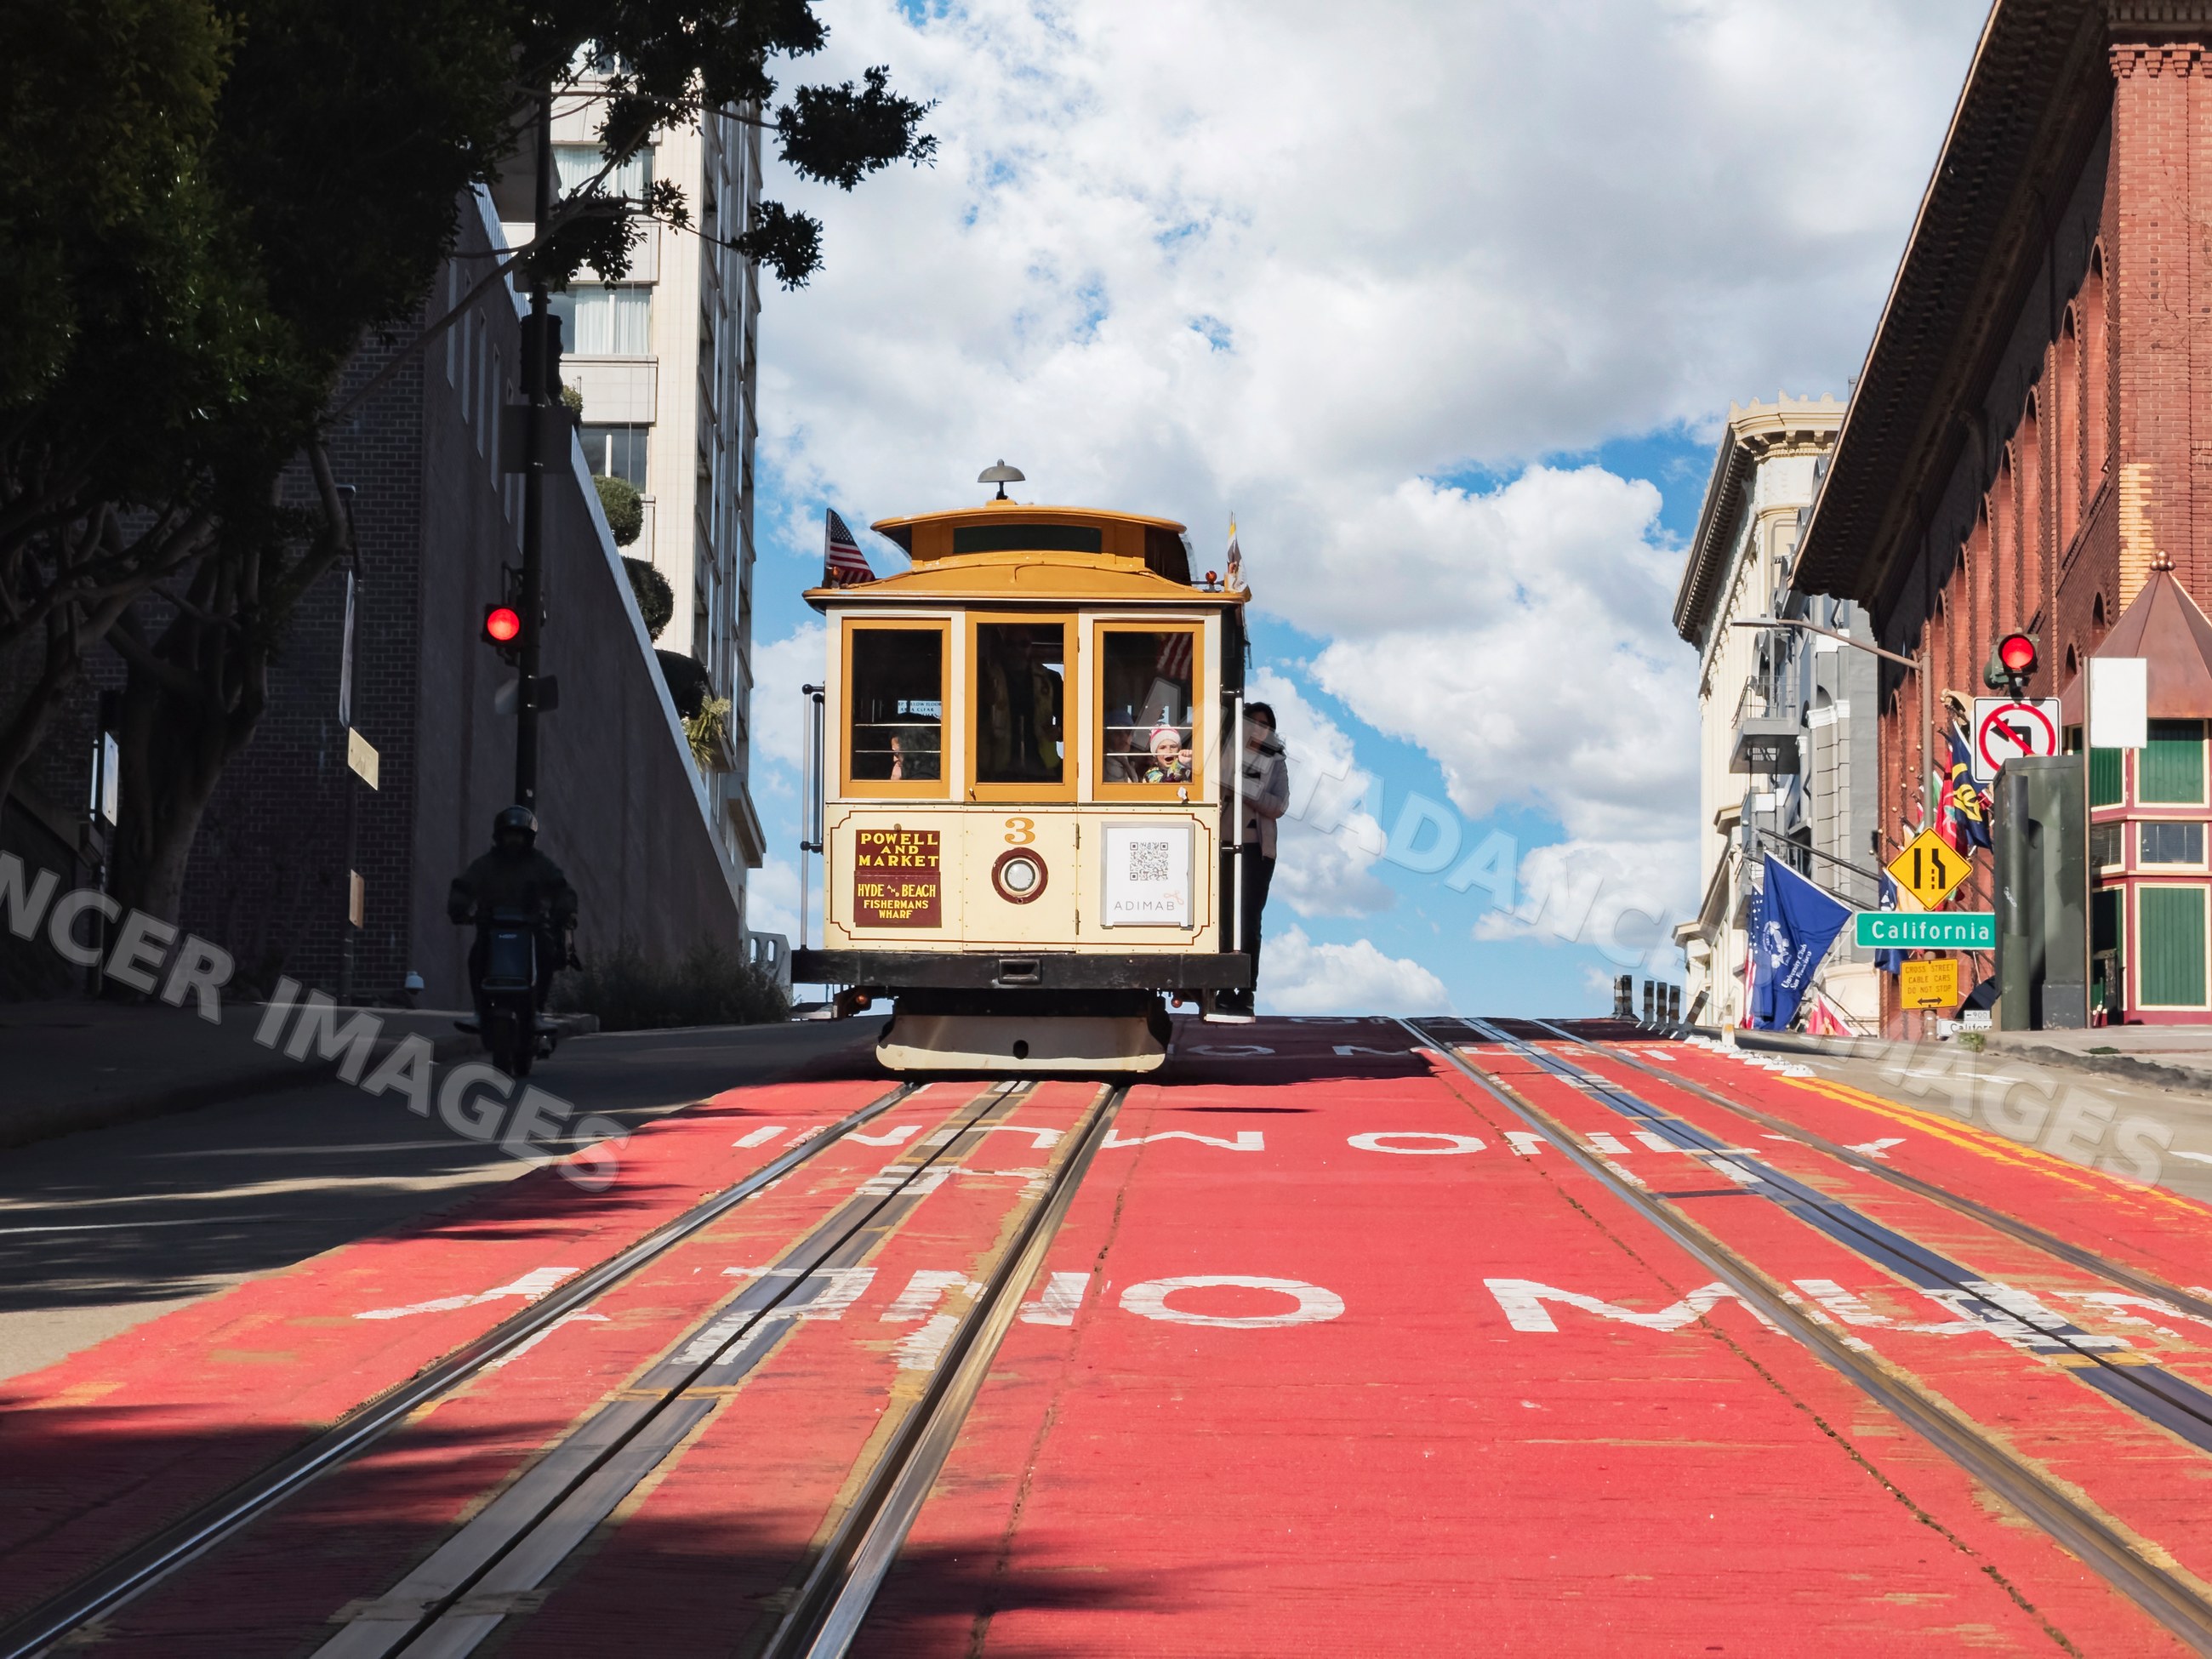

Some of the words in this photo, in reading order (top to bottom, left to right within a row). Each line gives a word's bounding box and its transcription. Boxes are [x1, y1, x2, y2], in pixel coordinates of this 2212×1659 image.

[1004, 817, 1036, 845] 3
[860, 833, 938, 845] POWELL
[880, 845, 919, 854] AND
[858, 855, 938, 867] MARKET
[858, 883, 885, 897] HYDE
[887, 884, 900, 898] AND
[901, 884, 937, 898] BEACH
[864, 899, 929, 909] FISHERMANS
[1114, 900, 1175, 911] ADIMAB
[879, 909, 913, 919] WHARF
[1871, 921, 1990, 940] California
[1905, 965, 1926, 974] CROSS
[1930, 963, 1954, 972] STREET
[1908, 976, 1929, 984] CABLE
[1936, 984, 1953, 993] STOP
